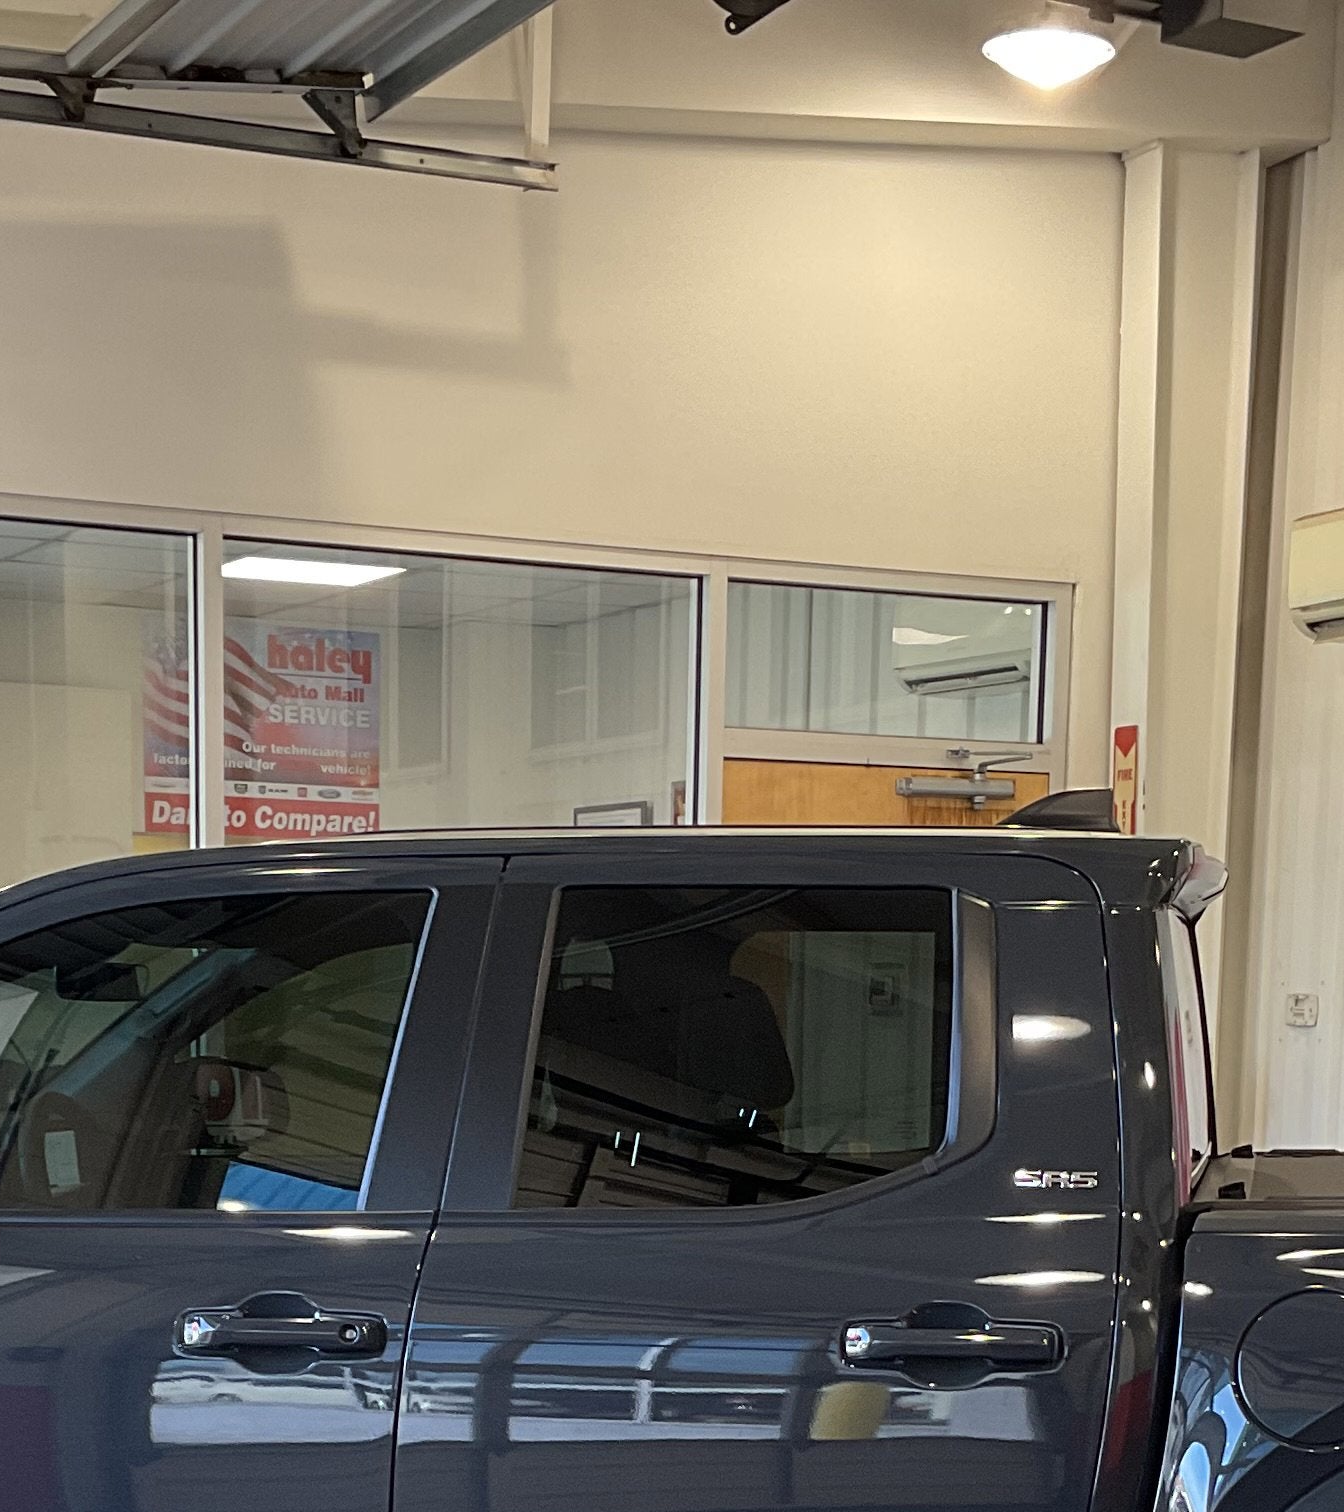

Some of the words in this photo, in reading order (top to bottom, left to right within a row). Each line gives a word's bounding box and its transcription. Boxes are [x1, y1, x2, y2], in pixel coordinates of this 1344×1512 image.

[267, 634, 372, 684] haley
[325, 685, 365, 702] Mall
[267, 703, 371, 728] SERVICE
[242, 741, 267, 753] Our
[271, 743, 347, 758] technicians
[350, 750, 370, 759] are
[154, 753, 190, 765] facto
[258, 758, 277, 771] for
[1117, 768, 1133, 781] FIRE
[152, 799, 190, 825] Da
[224, 804, 246, 828] to
[254, 804, 376, 836] Compare!
[1013, 1168, 1098, 1189] SR5
